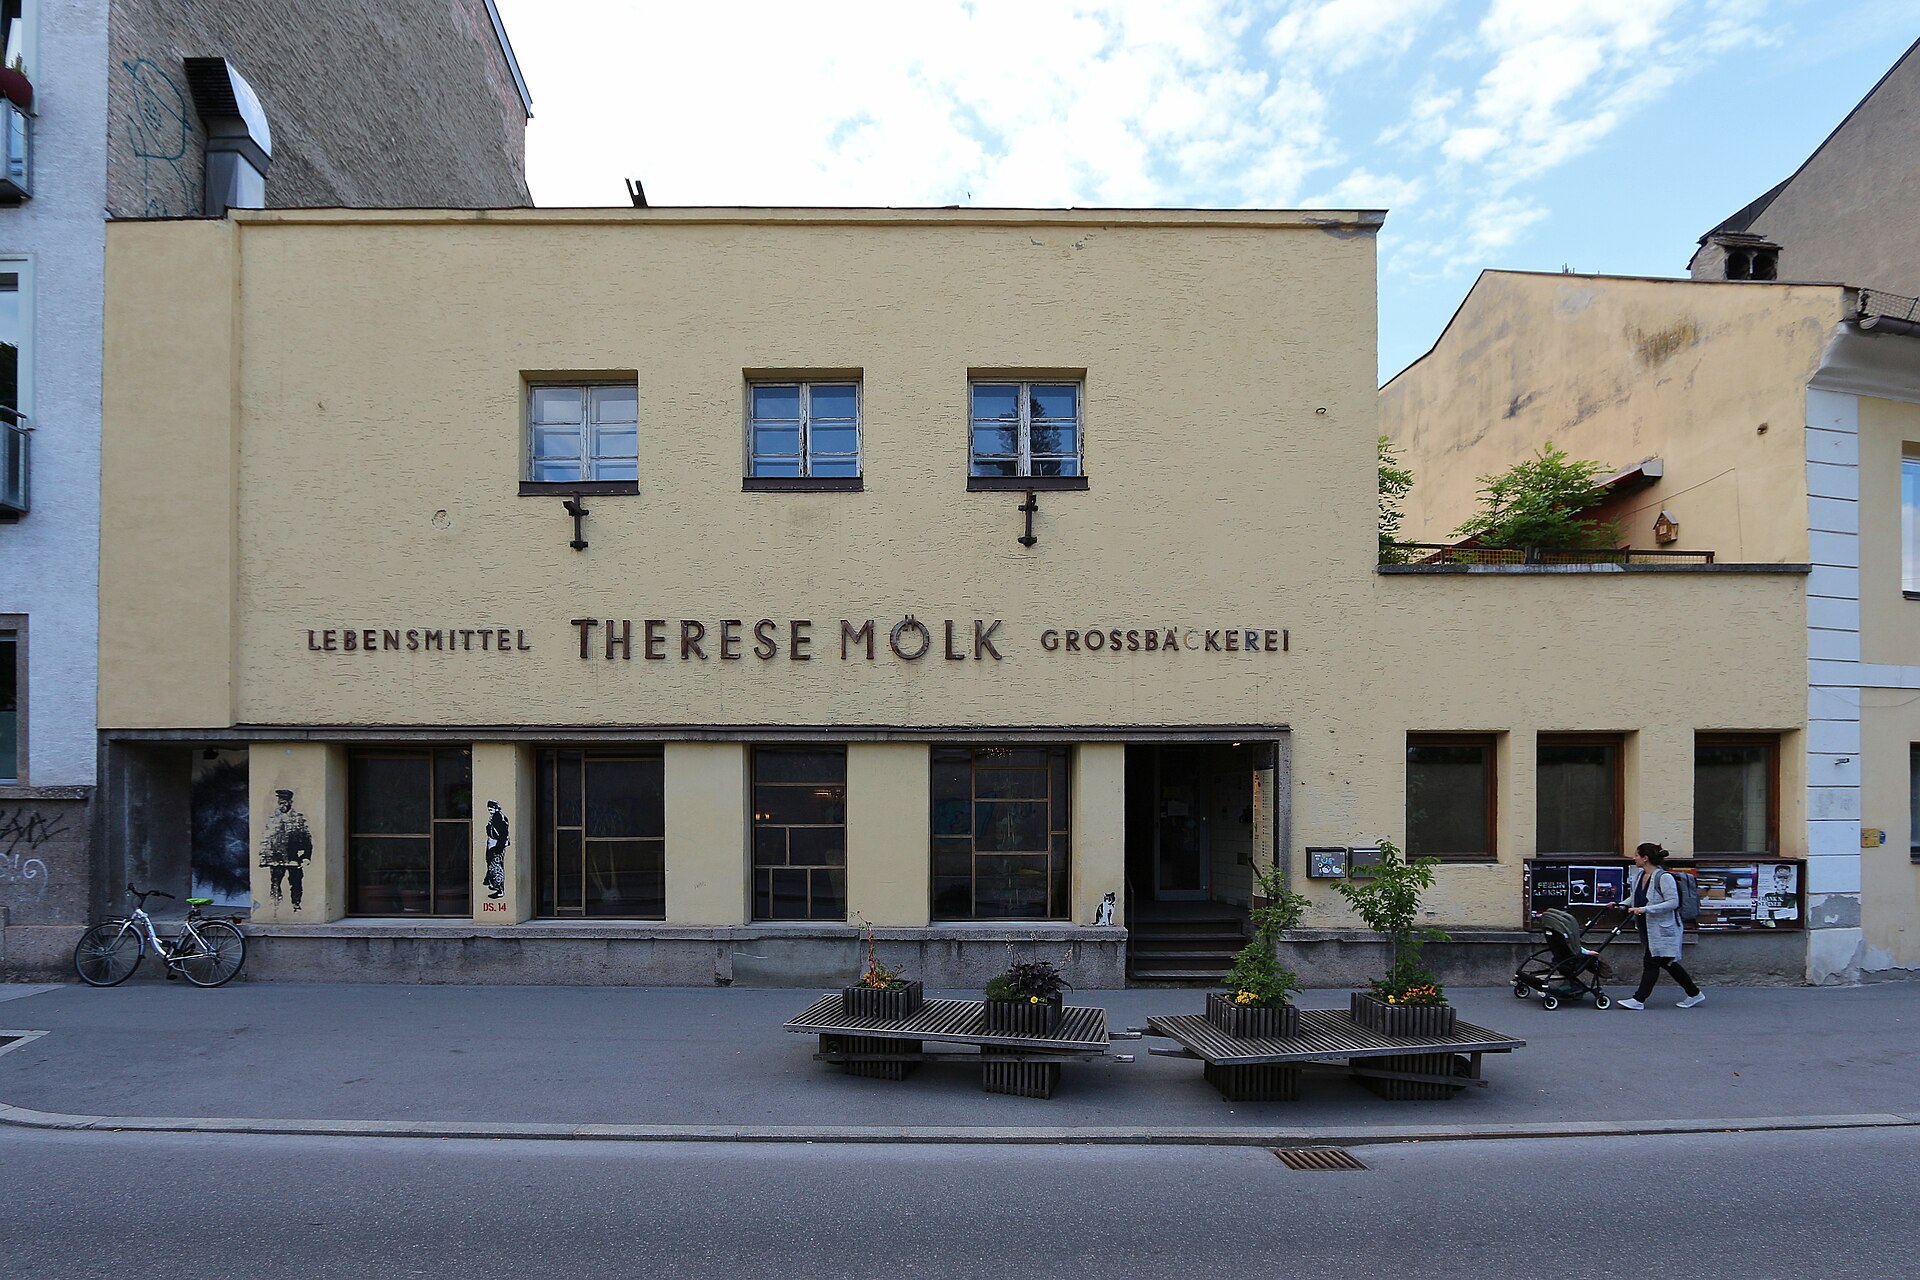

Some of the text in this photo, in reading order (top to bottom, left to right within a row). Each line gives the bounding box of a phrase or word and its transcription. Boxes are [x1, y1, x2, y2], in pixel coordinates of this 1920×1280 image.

[308, 614, 1289, 661] LEBENSMITTEL THERESE MÖLK GROSSBÄCKEREI
[498, 902, 507, 911] 14
